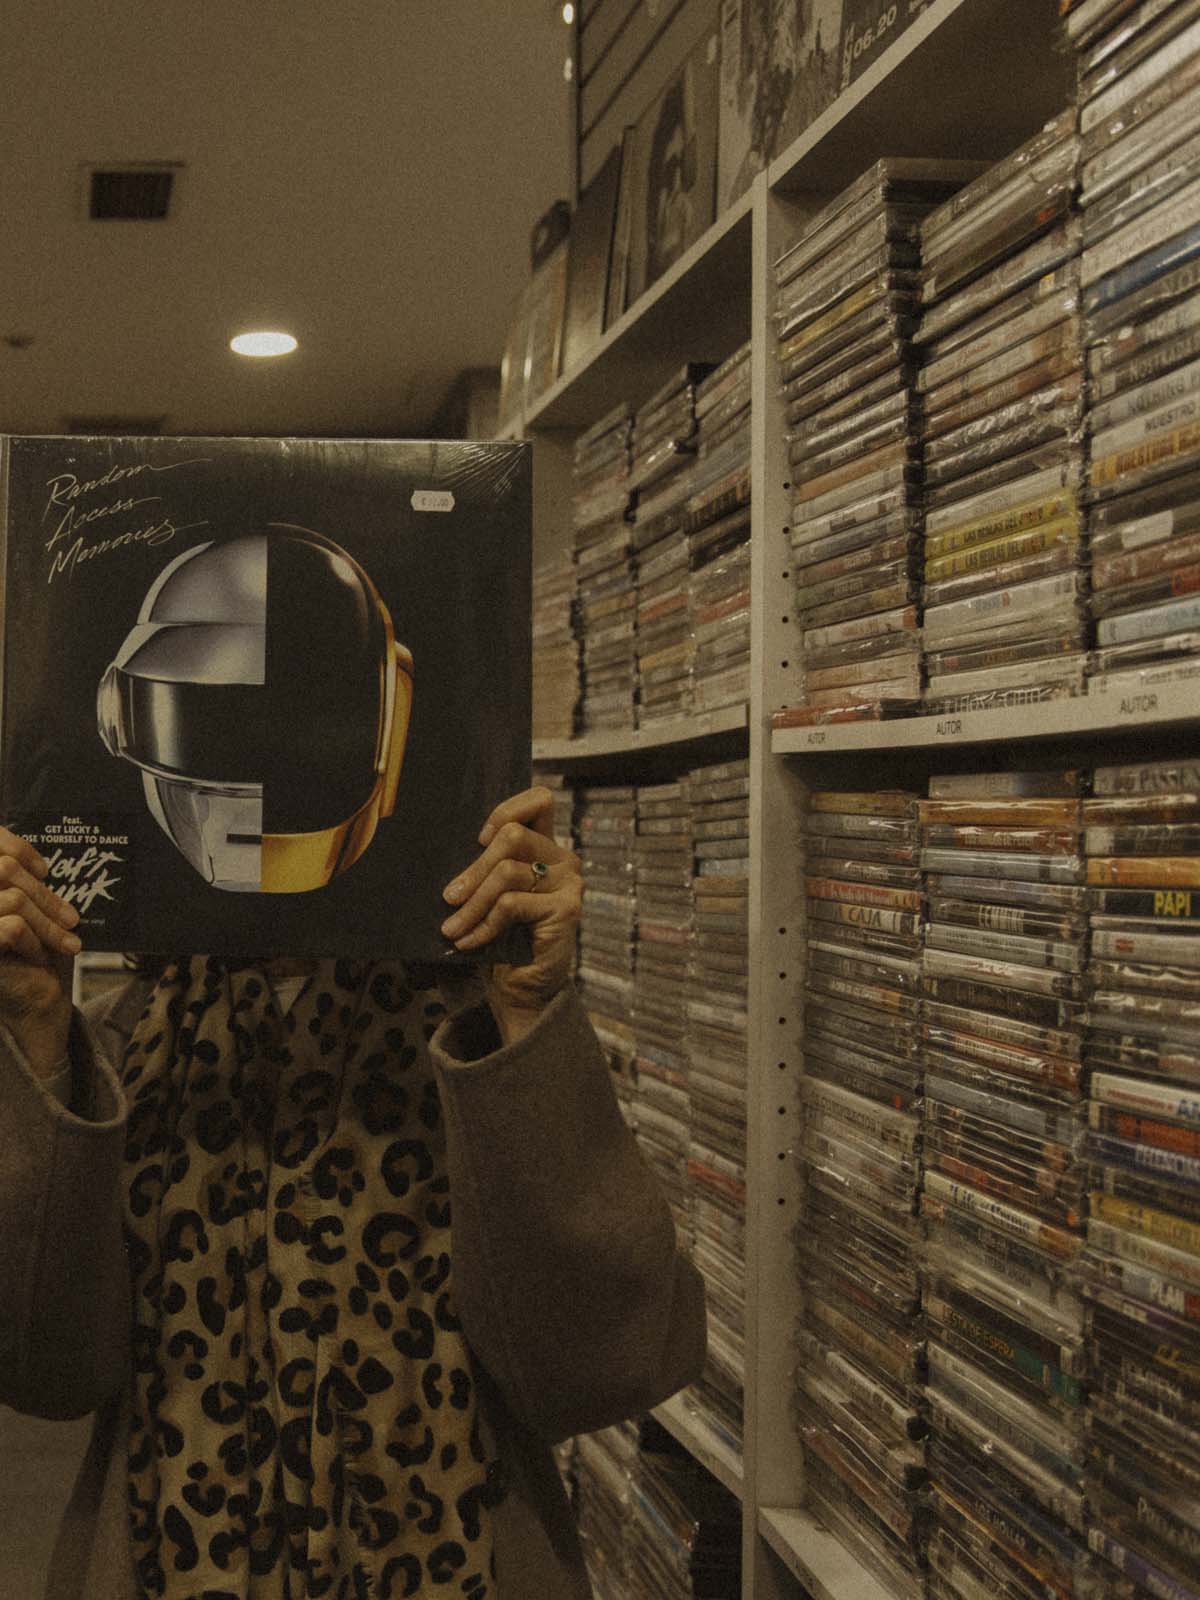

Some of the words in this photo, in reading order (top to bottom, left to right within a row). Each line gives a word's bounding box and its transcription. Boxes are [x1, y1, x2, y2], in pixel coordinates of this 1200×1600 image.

[41, 457, 213, 526] Random
[45, 496, 162, 552] Access
[47, 518, 209, 584] Memories
[1120, 694, 1158, 713] AUTOR
[936, 719, 962, 735] AUTOR
[807, 732, 826, 745] AUTOR
[62, 815, 83, 825] Feat.
[45, 825, 62, 834] GET
[63, 825, 91, 834] LUCKY
[17, 834, 38, 843] OSE
[41, 834, 83, 844] YOURSELF
[84, 835, 98, 844] TO
[98, 835, 129, 845] DANCE
[1154, 891, 1191, 916] PAPI
